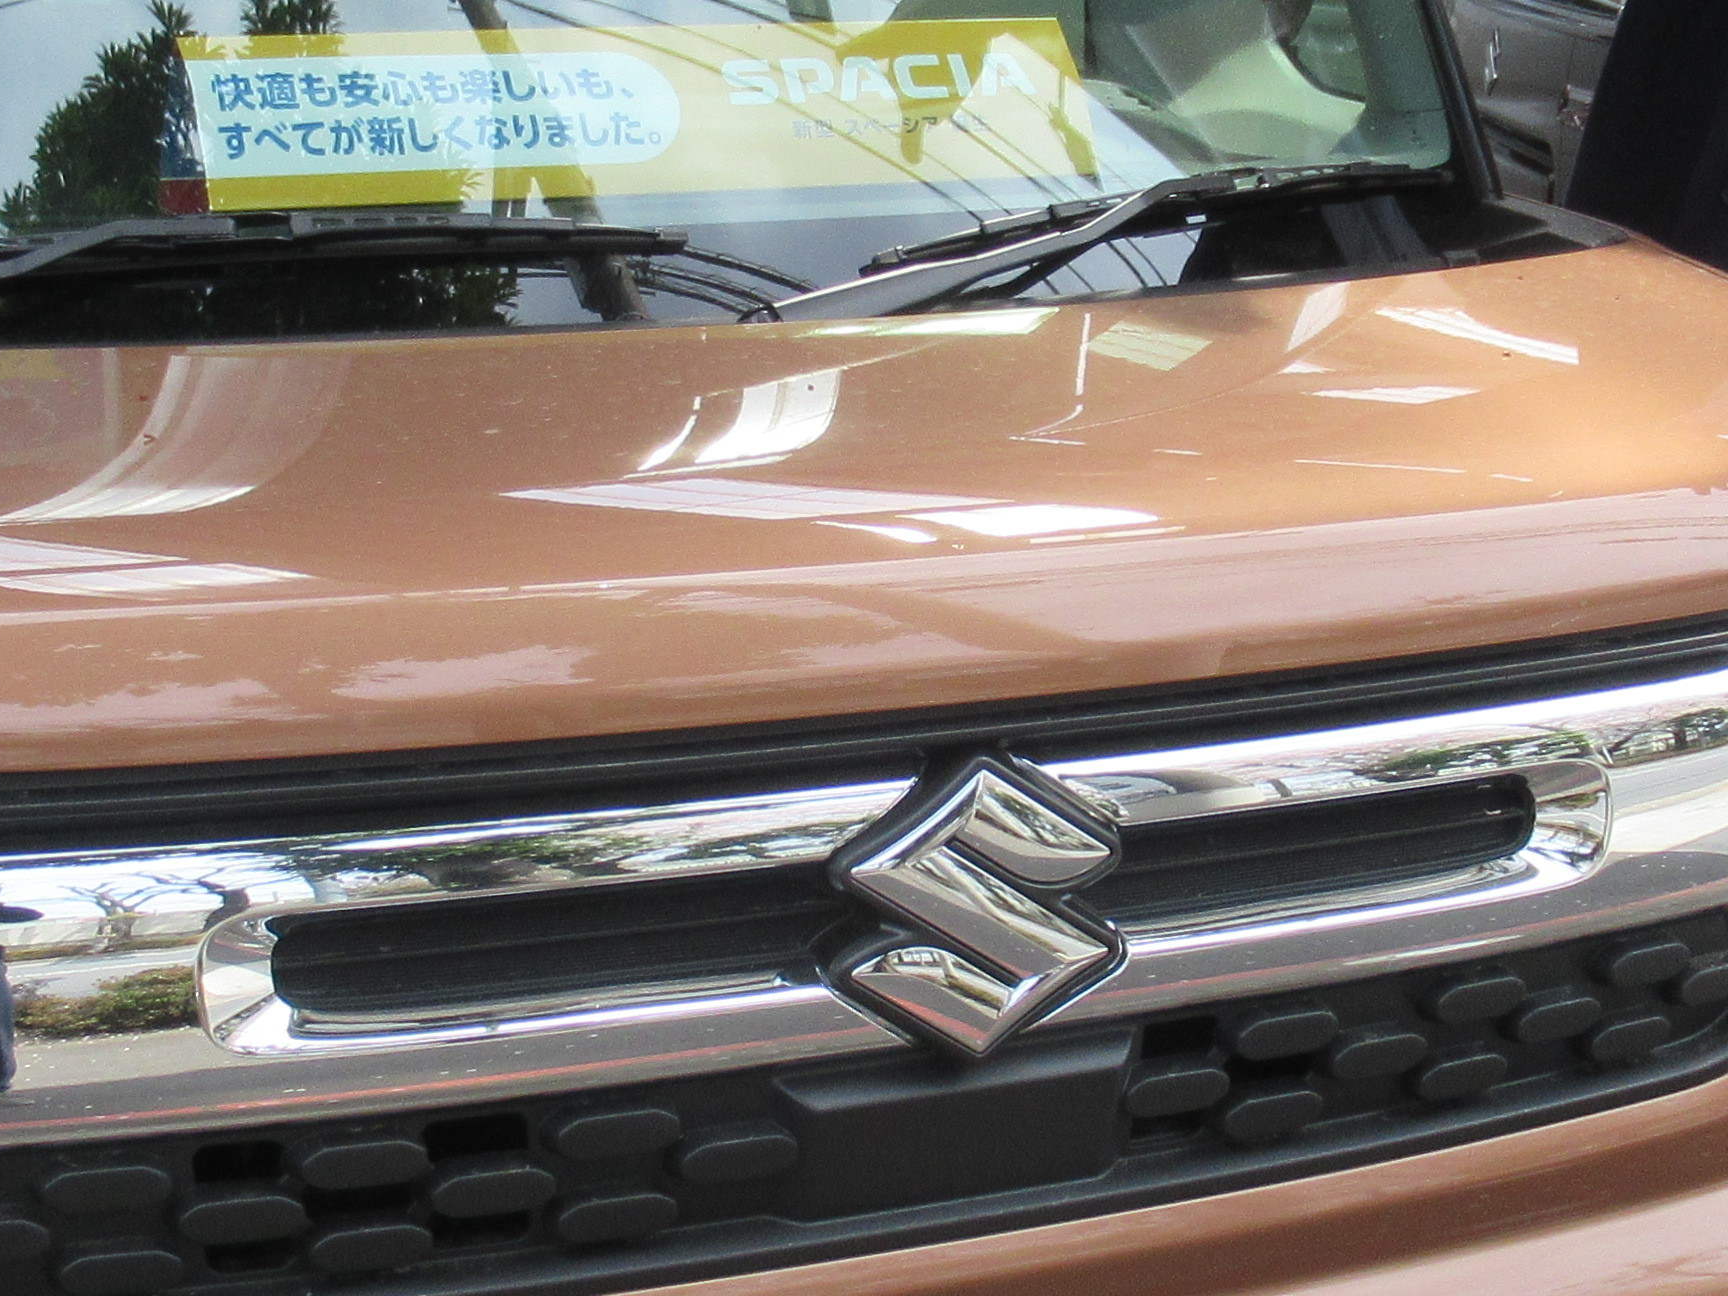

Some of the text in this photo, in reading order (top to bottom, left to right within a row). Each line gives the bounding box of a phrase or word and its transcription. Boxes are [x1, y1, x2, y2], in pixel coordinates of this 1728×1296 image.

[211, 67, 636, 112] 快適も安心も楽しいも、
[721, 54, 1039, 104] SPACIA
[218, 111, 663, 159] すべてが新しくなりました。
